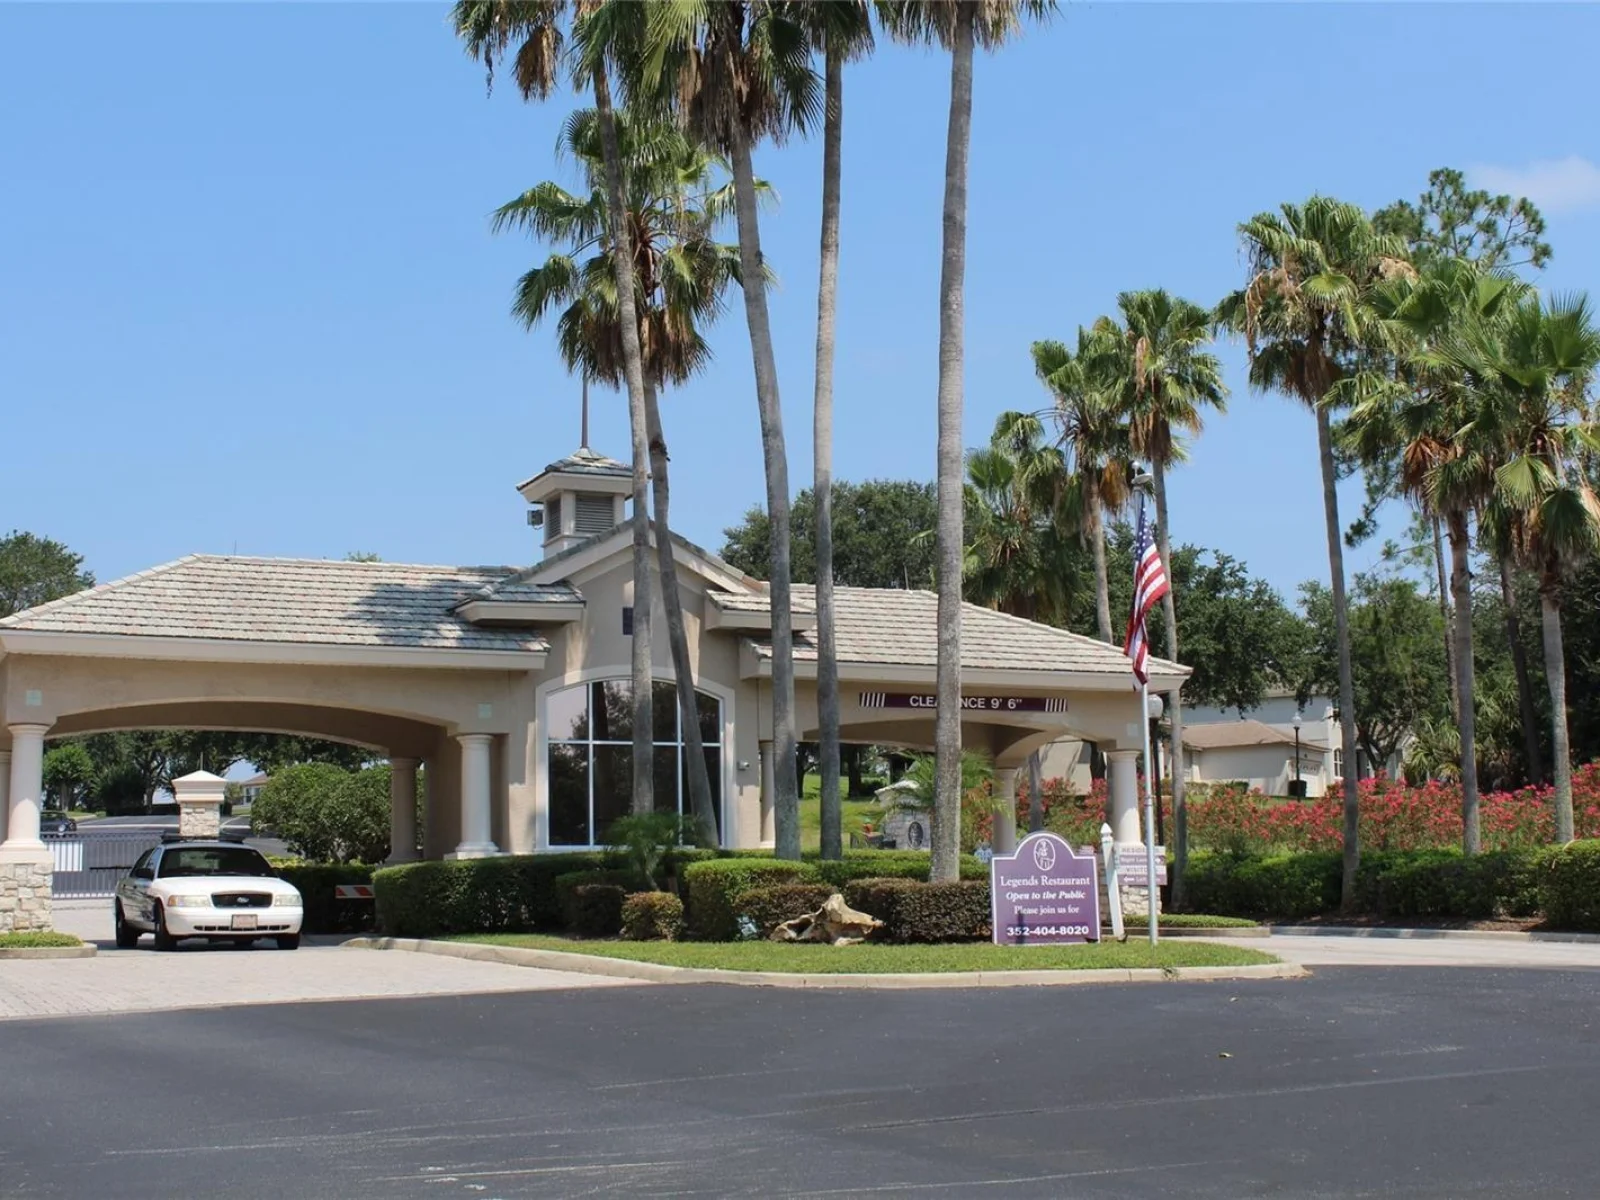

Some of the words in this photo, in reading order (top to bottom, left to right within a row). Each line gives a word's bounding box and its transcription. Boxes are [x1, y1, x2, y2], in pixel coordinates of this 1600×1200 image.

[909, 695, 986, 709] CLENCE
[1000, 875, 1039, 887] Legends
[1041, 875, 1090, 886] Restaurant
[1006, 892, 1029, 902] Open
[1031, 892, 1040, 900] to
[1042, 891, 1057, 900] the
[1058, 890, 1086, 899] Public
[1014, 905, 1038, 914] Please
[1039, 905, 1056, 915] join
[1068, 905, 1080, 913] for
[1007, 926, 1089, 936] 352-404-8020
